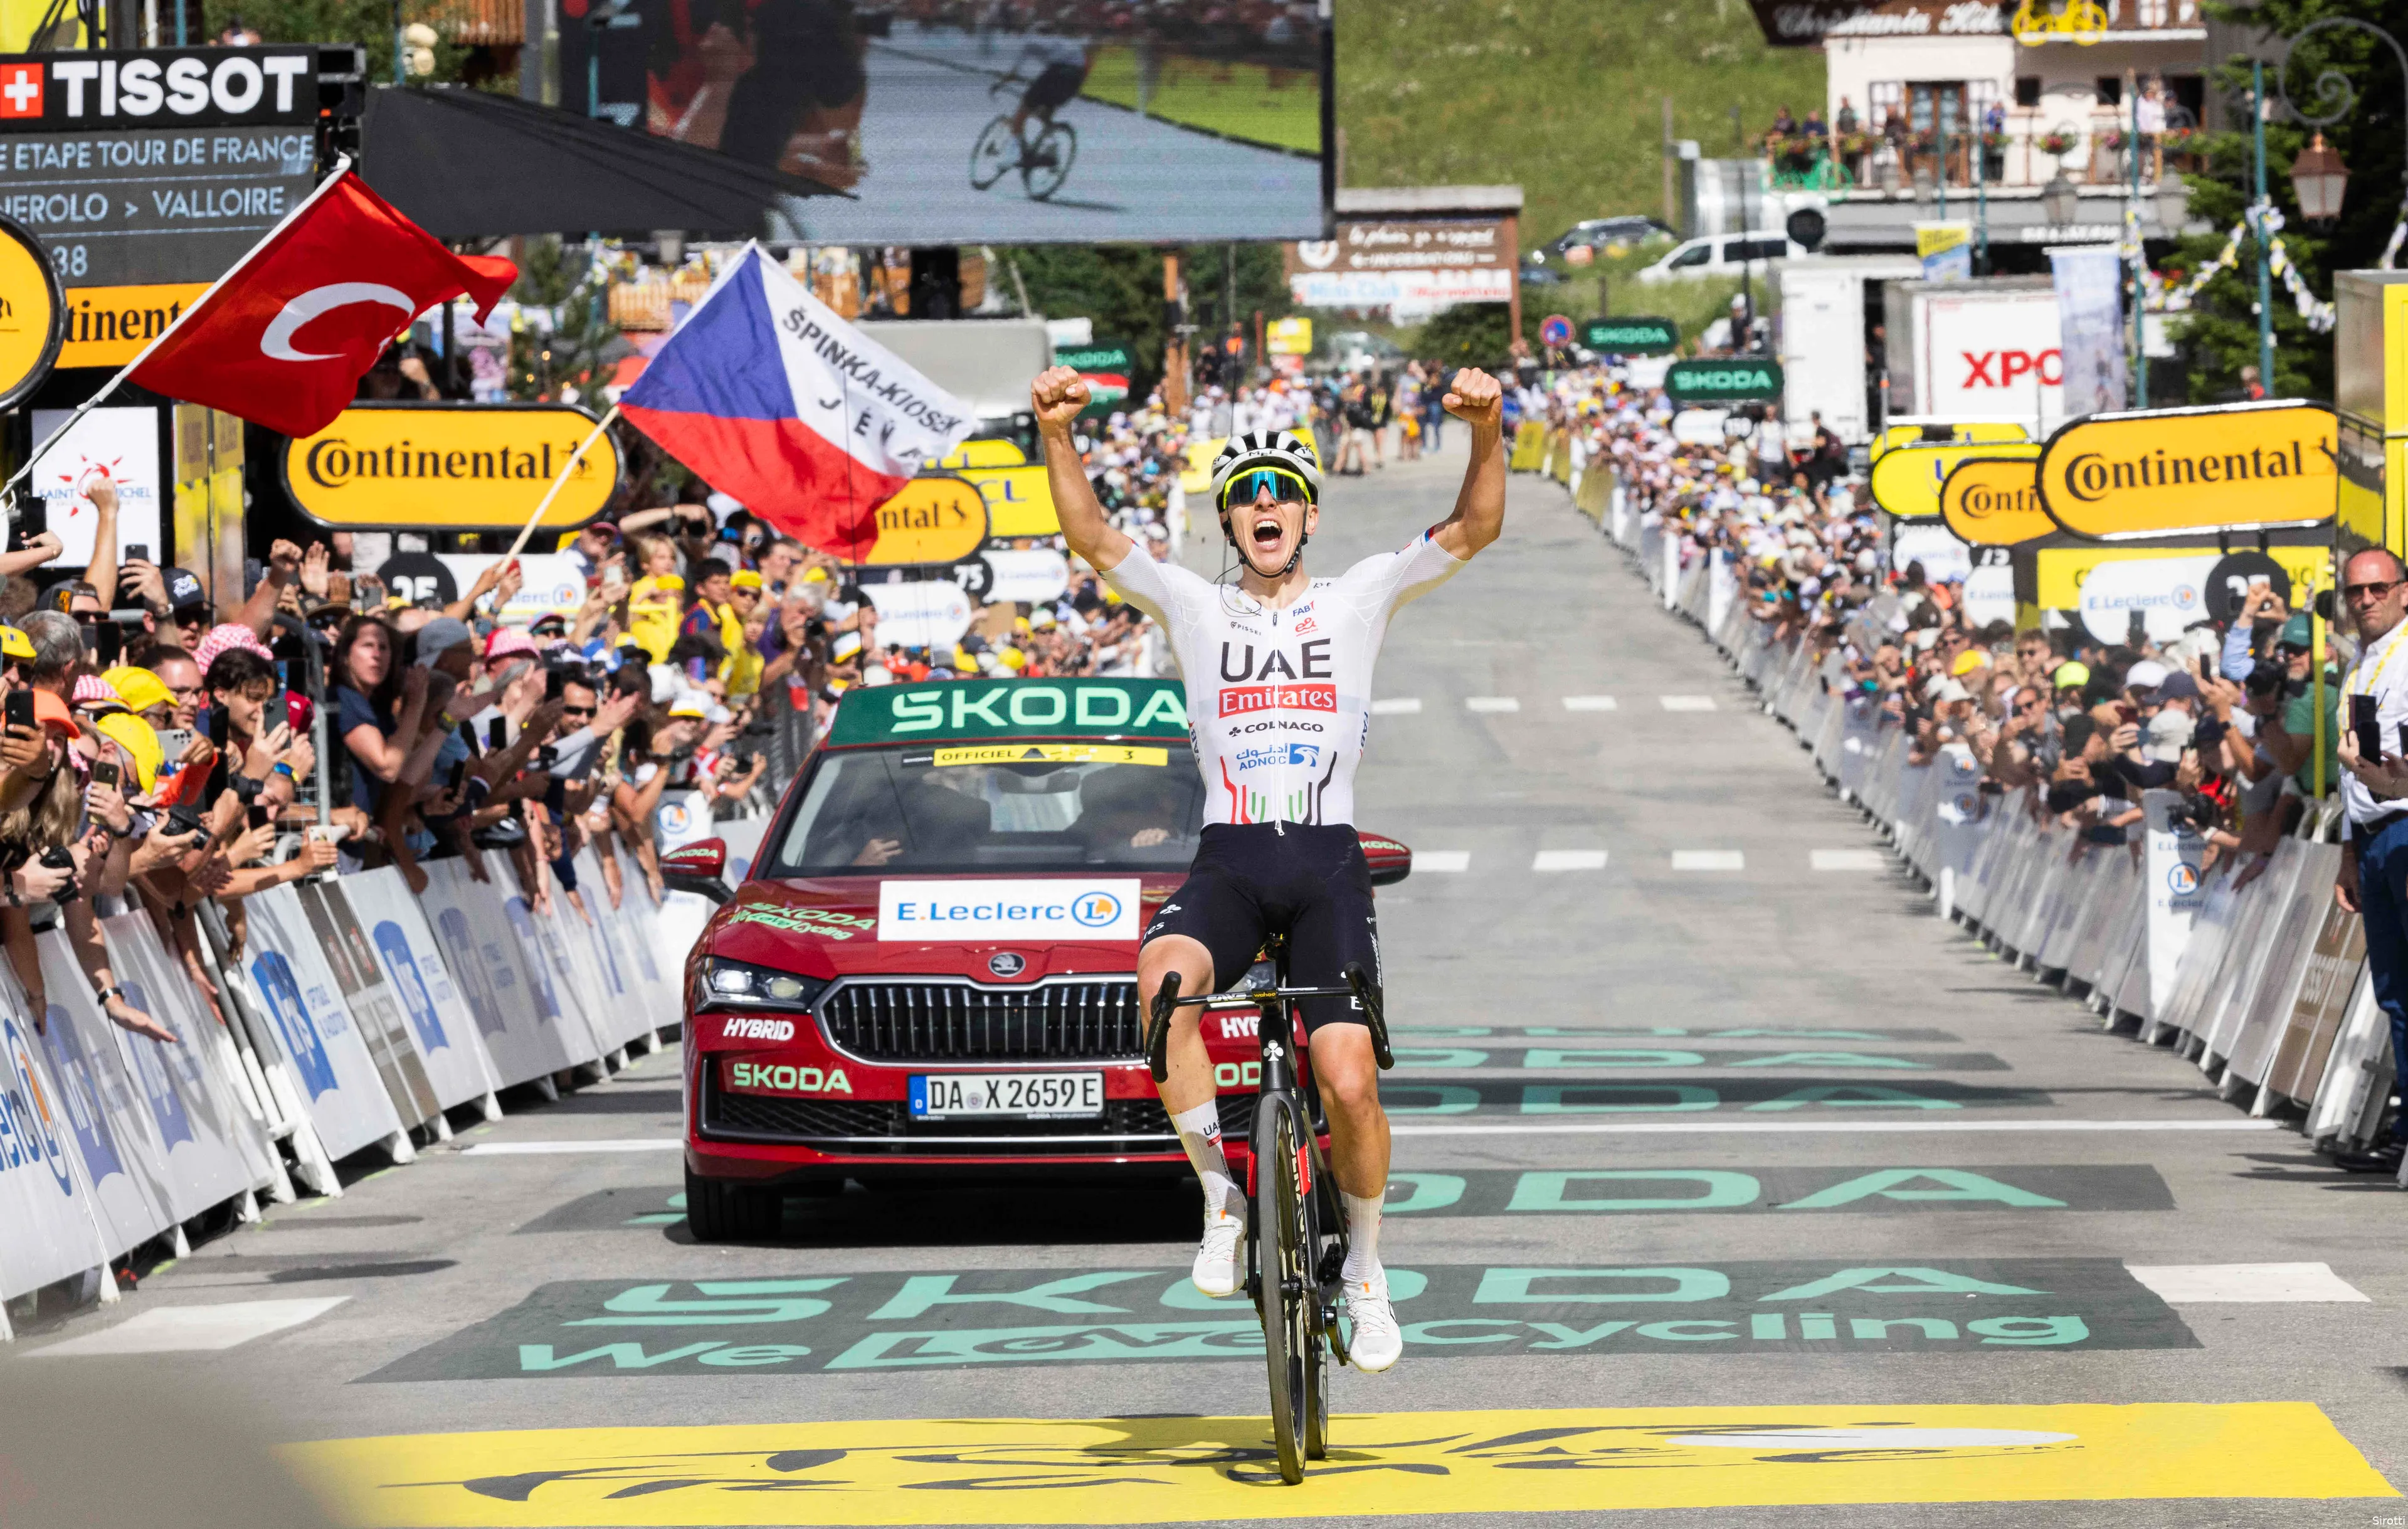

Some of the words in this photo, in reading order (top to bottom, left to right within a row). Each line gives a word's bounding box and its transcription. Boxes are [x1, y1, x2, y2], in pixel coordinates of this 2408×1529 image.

[53, 55, 308, 117] TISSOT
[15, 141, 92, 170] ETAPE
[97, 139, 167, 167] TOUR
[173, 137, 206, 166] DE
[213, 134, 314, 164] FRANCE
[152, 186, 285, 219] VALLOIRE
[307, 438, 552, 487] Continental
[2064, 440, 2303, 502] Continental
[953, 563, 985, 590] 75
[1293, 605, 1311, 617] FAB
[1220, 638, 1333, 683] UAE
[1222, 689, 1334, 714] Emirates
[1245, 721, 1324, 734] COLNAGO
[941, 749, 1015, 761] OFFICIEL
[1124, 750, 1133, 760] 3
[1239, 755, 1287, 771] ADNOC
[898, 902, 1065, 923] E.Leclerc
[722, 1018, 795, 1041] HYBRID
[930, 1080, 964, 1109] DA
